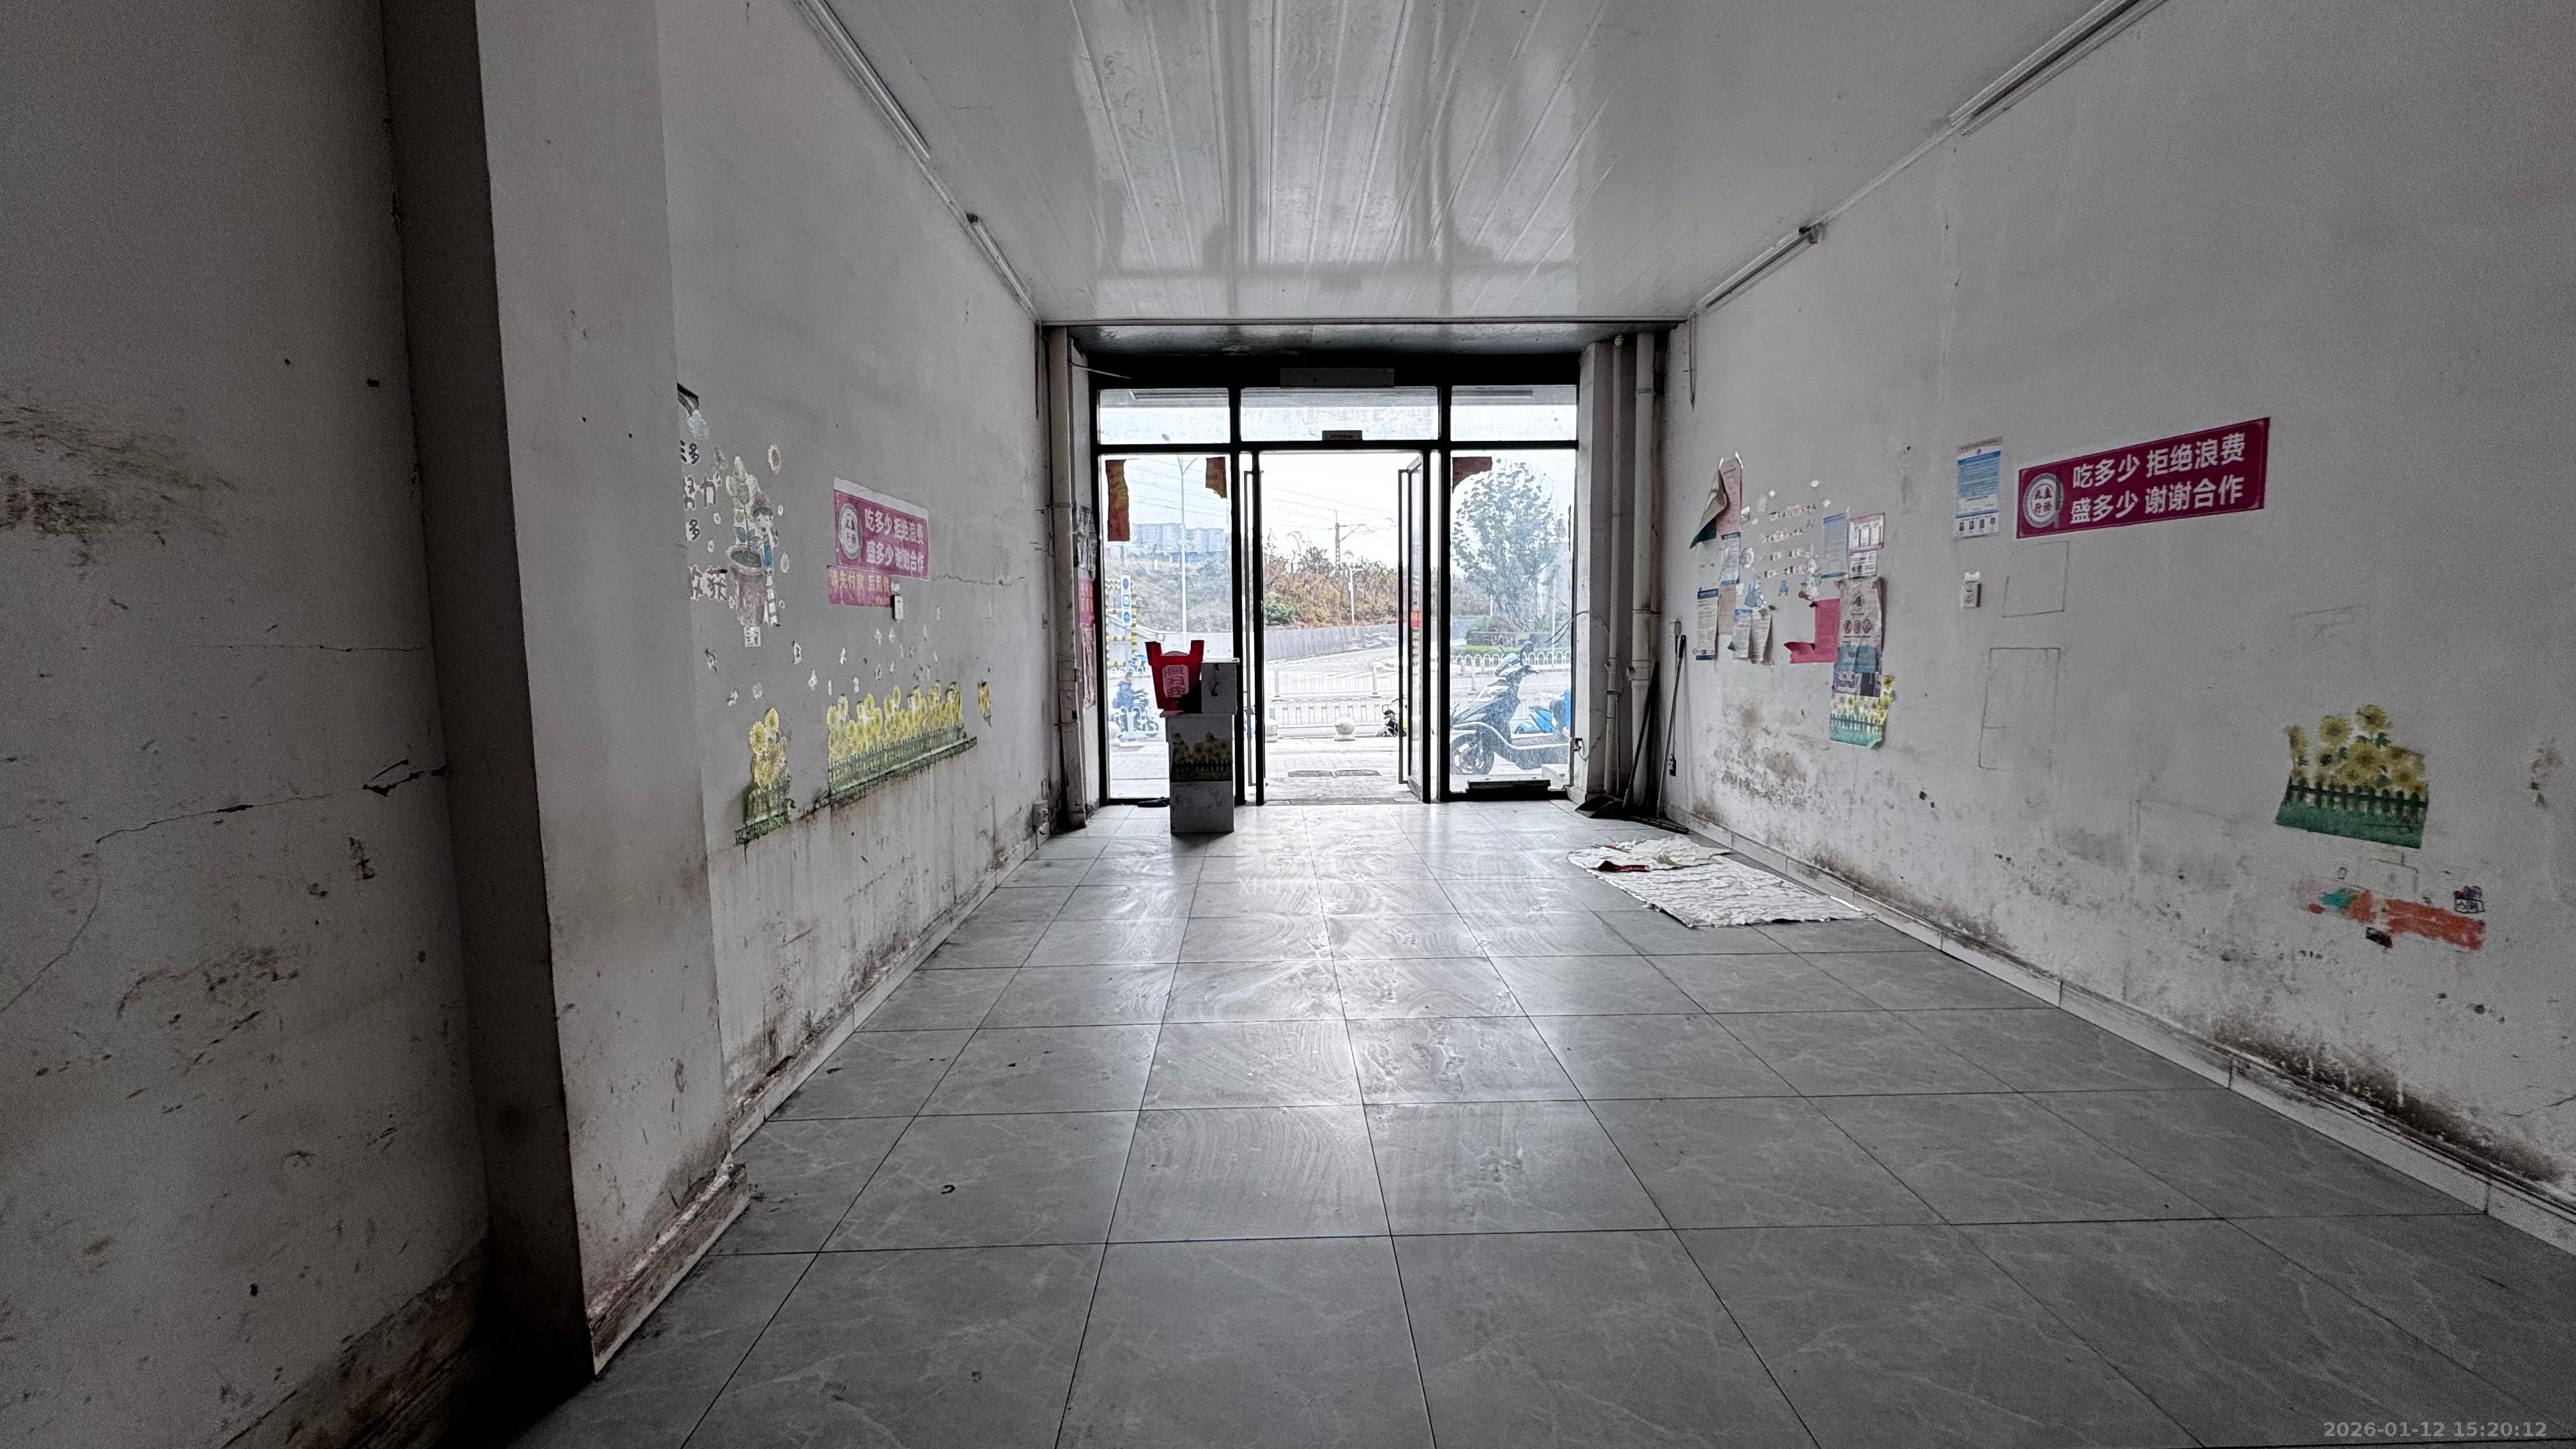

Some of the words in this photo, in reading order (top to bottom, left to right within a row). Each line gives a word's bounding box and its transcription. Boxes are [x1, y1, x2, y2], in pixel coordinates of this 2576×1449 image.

[2072, 454, 2140, 489] 吃多少
[2145, 432, 2246, 478] 拒绝浪费
[2070, 490, 2138, 525] 盛多少
[2144, 474, 2245, 514] 谢谢合作
[864, 507, 893, 535] 吃多少
[893, 518, 924, 545] 拒绝浪费
[866, 540, 894, 567] 盛多少
[895, 546, 925, 573] 谢谢合作
